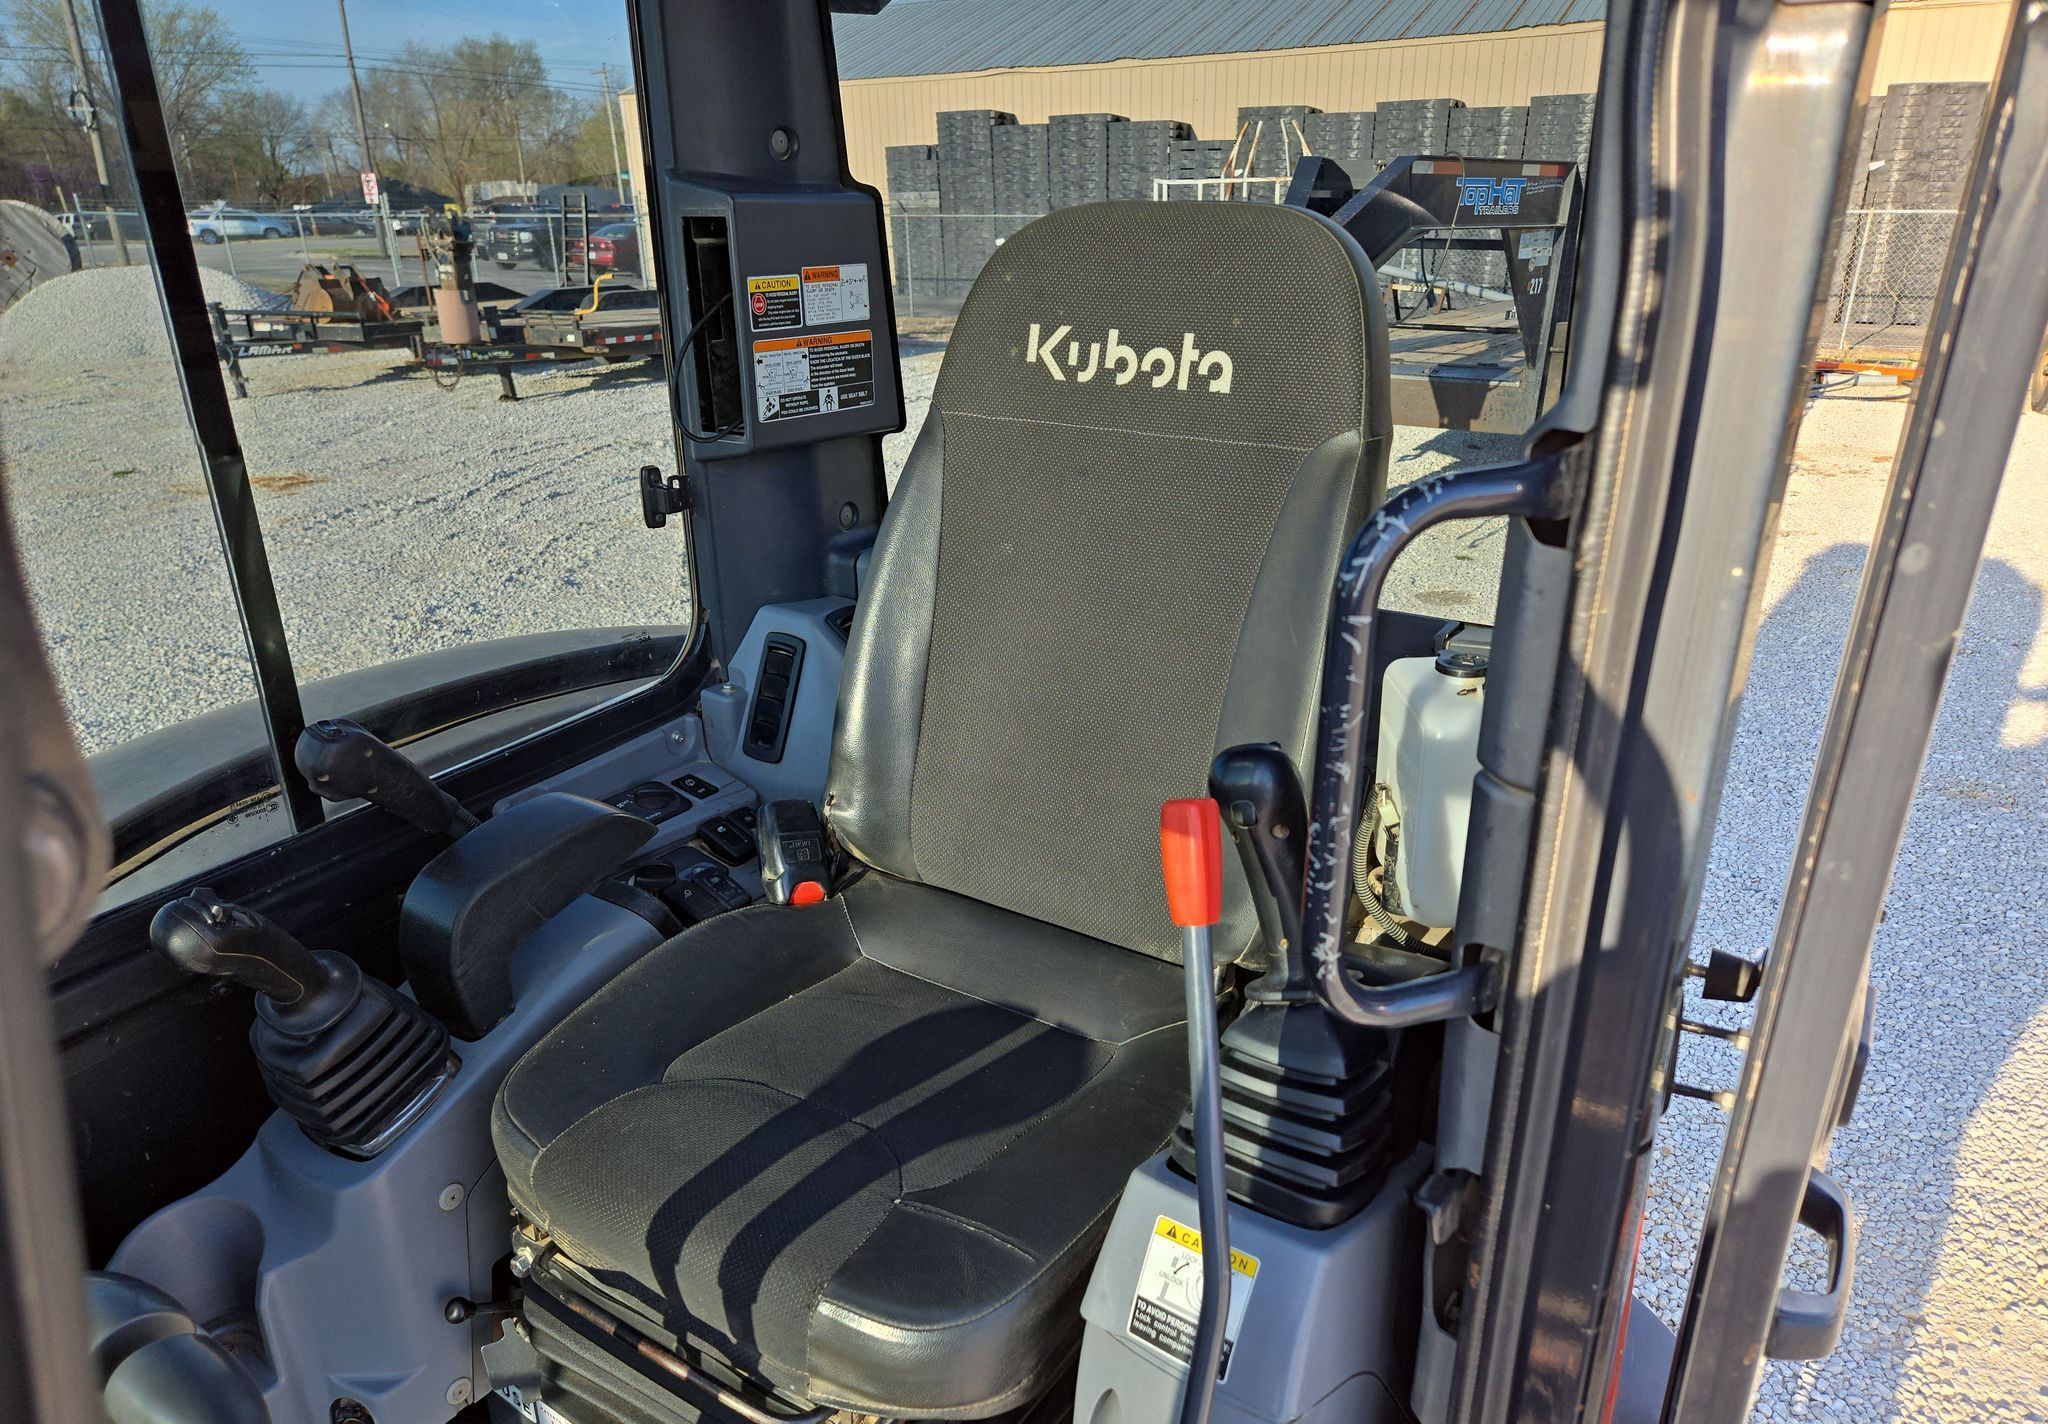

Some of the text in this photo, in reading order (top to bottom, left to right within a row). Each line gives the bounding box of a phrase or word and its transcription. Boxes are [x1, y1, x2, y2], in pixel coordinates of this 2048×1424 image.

[1479, 205, 1520, 215] TRAILERS
[812, 269, 839, 280] WARNING
[761, 279, 792, 290] CAUTION
[1530, 277, 1543, 295] 217
[803, 336, 833, 346] WARNING
[1026, 323, 1233, 394] Kubota
[1181, 1252, 1198, 1263] LOCK
[1182, 1233, 1249, 1271] CAON
[1159, 1270, 1183, 1286] UNLOCK
[1137, 1298, 1147, 1312] TO
[1146, 1303, 1167, 1322] AVOID
[1133, 1318, 1157, 1339] leaving
[1135, 1309, 1152, 1324] Lock
[1153, 1319, 1178, 1337] control
